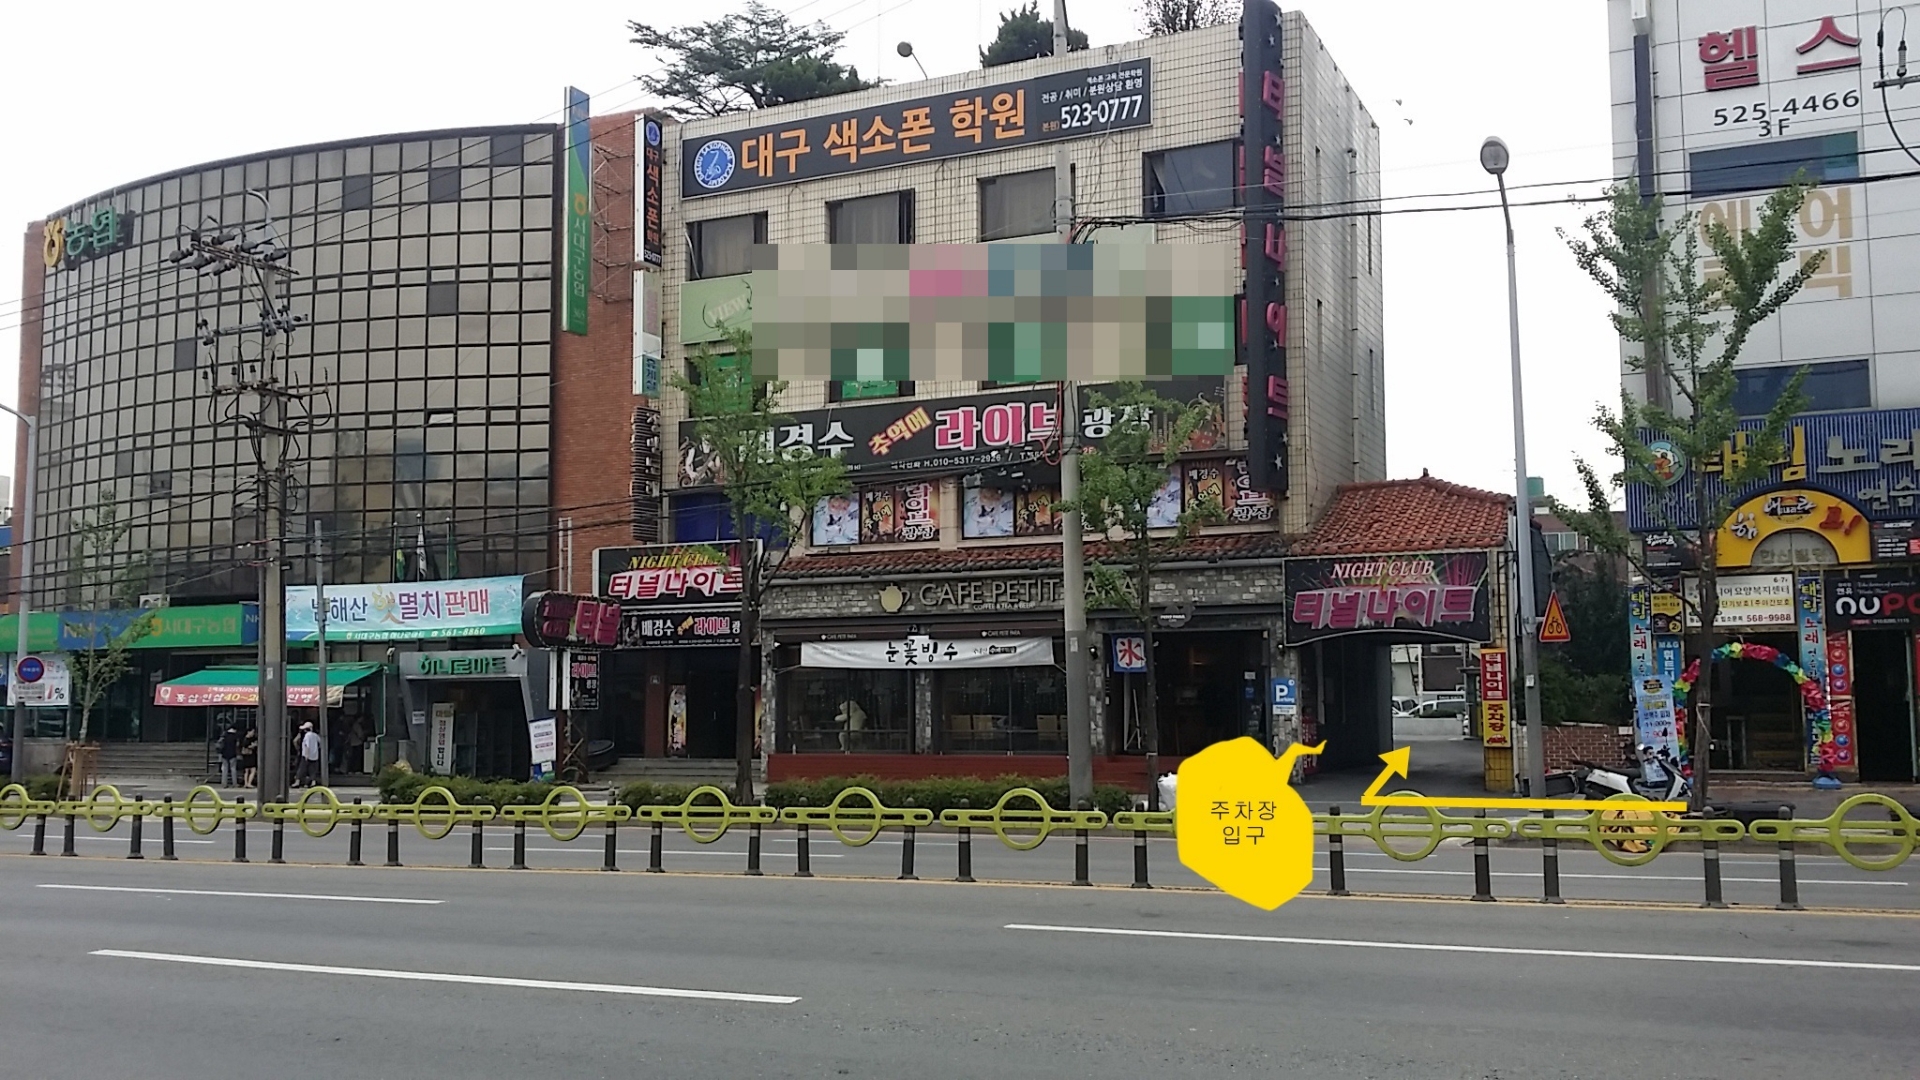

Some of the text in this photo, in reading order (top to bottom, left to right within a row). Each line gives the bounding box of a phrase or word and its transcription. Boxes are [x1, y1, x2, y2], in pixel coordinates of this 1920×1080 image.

[1699, 16, 1862, 91] 헬스
[1041, 91, 1058, 104] 전공
[1064, 87, 1081, 99] 취미
[1088, 79, 1123, 96] 분원상담
[1125, 77, 1143, 90] 환영
[1060, 94, 1143, 129] 523-0777
[1713, 89, 1860, 127] 525-4466
[741, 88, 1026, 178] 대구 색소폰 학원
[646, 147, 659, 161] 대구
[646, 163, 659, 230] 색소폰
[65, 206, 116, 256] 농협
[1262, 70, 1289, 420] 터널나이트
[573, 217, 586, 298] 서대구농협
[868, 406, 932, 456] 추억에
[1188, 468, 1220, 480] 배경수
[628, 552, 727, 569] NIGHT CLU
[1331, 560, 1435, 579] NIGHT CLUB
[608, 571, 743, 600] 터널나이트
[918, 581, 983, 606] CAFE
[991, 578, 1060, 604] PETIT
[444, 588, 490, 617] 판매
[1292, 586, 1477, 630] 터널나이트
[440, 627, 486, 637] 561-8860
[641, 618, 675, 637] 배경수
[693, 616, 731, 636] 라이브
[731, 620, 741, 634] 광
[1745, 613, 1792, 623] 568-9988
[1804, 617, 1819, 644] 노래
[1633, 623, 1647, 650] 노래
[417, 653, 507, 676] 하나로마트
[886, 639, 958, 666] 눈꽃빙수
[1118, 638, 1146, 667] 氷
[571, 662, 597, 678] 라이브
[1485, 653, 1503, 699] 터널나이트
[1487, 703, 1506, 732] 주차장
